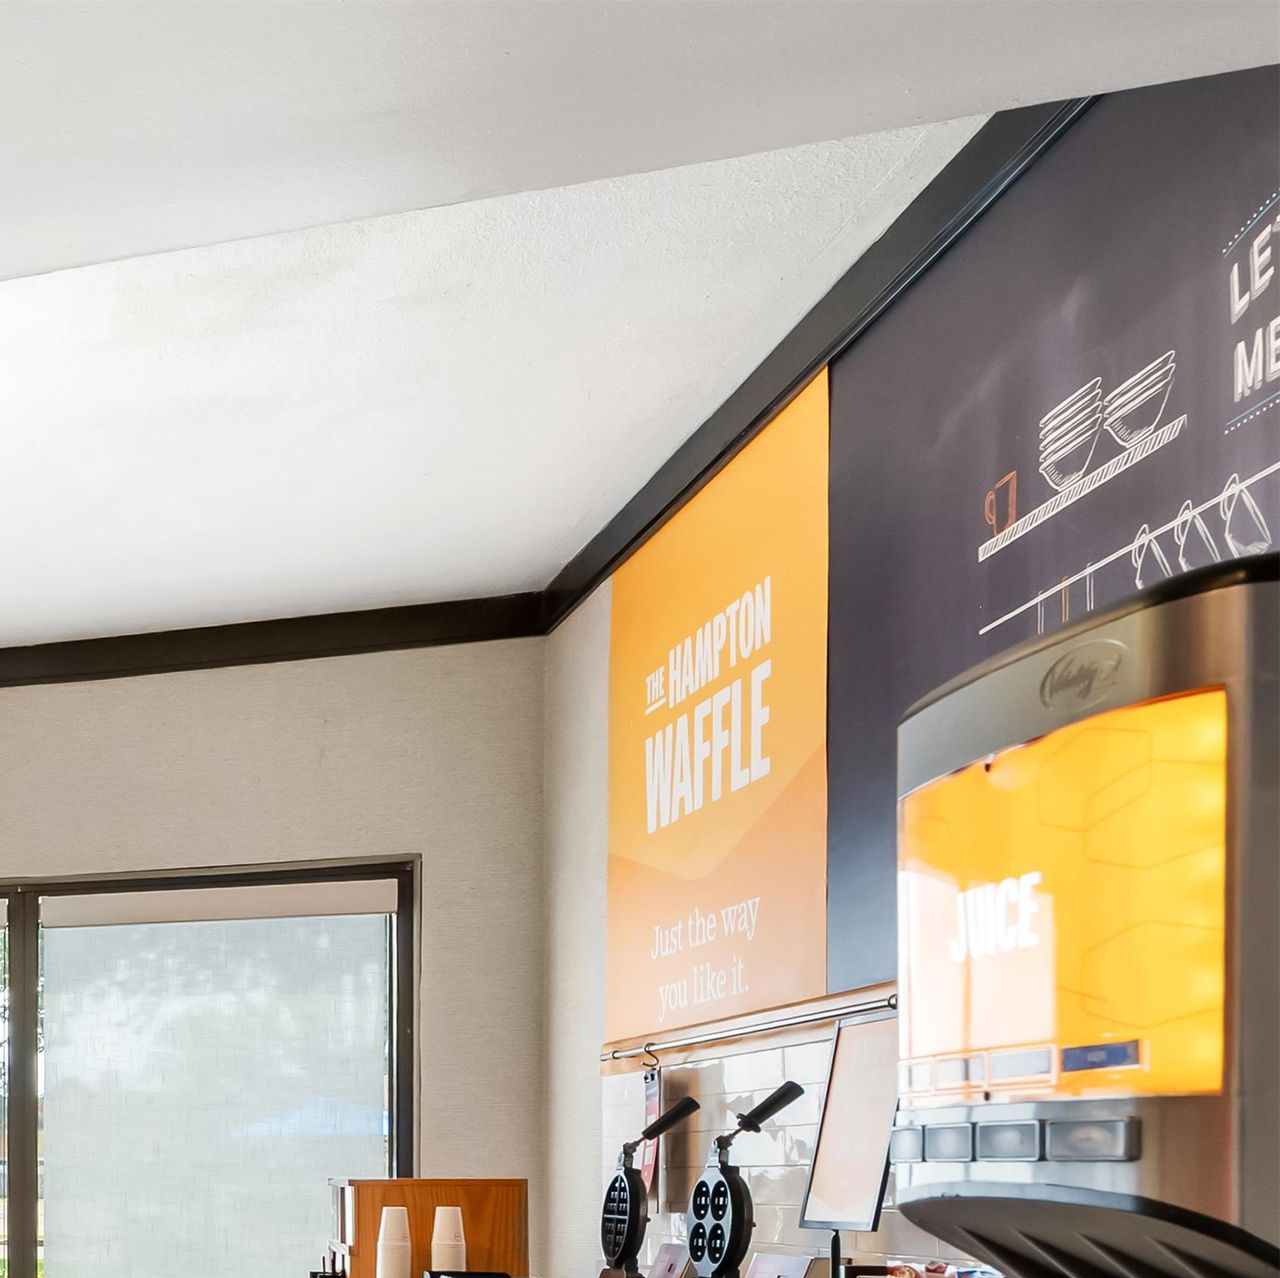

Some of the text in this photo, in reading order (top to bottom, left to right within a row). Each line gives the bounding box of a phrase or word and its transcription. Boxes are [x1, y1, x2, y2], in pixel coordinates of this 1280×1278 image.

[1229, 213, 1280, 326] LE
[645, 575, 772, 709] THE HAMPTON
[644, 658, 772, 836] WAFFLE
[651, 896, 761, 960] Just the way
[948, 870, 1043, 964] JUICE
[658, 953, 749, 1023] you like it.
